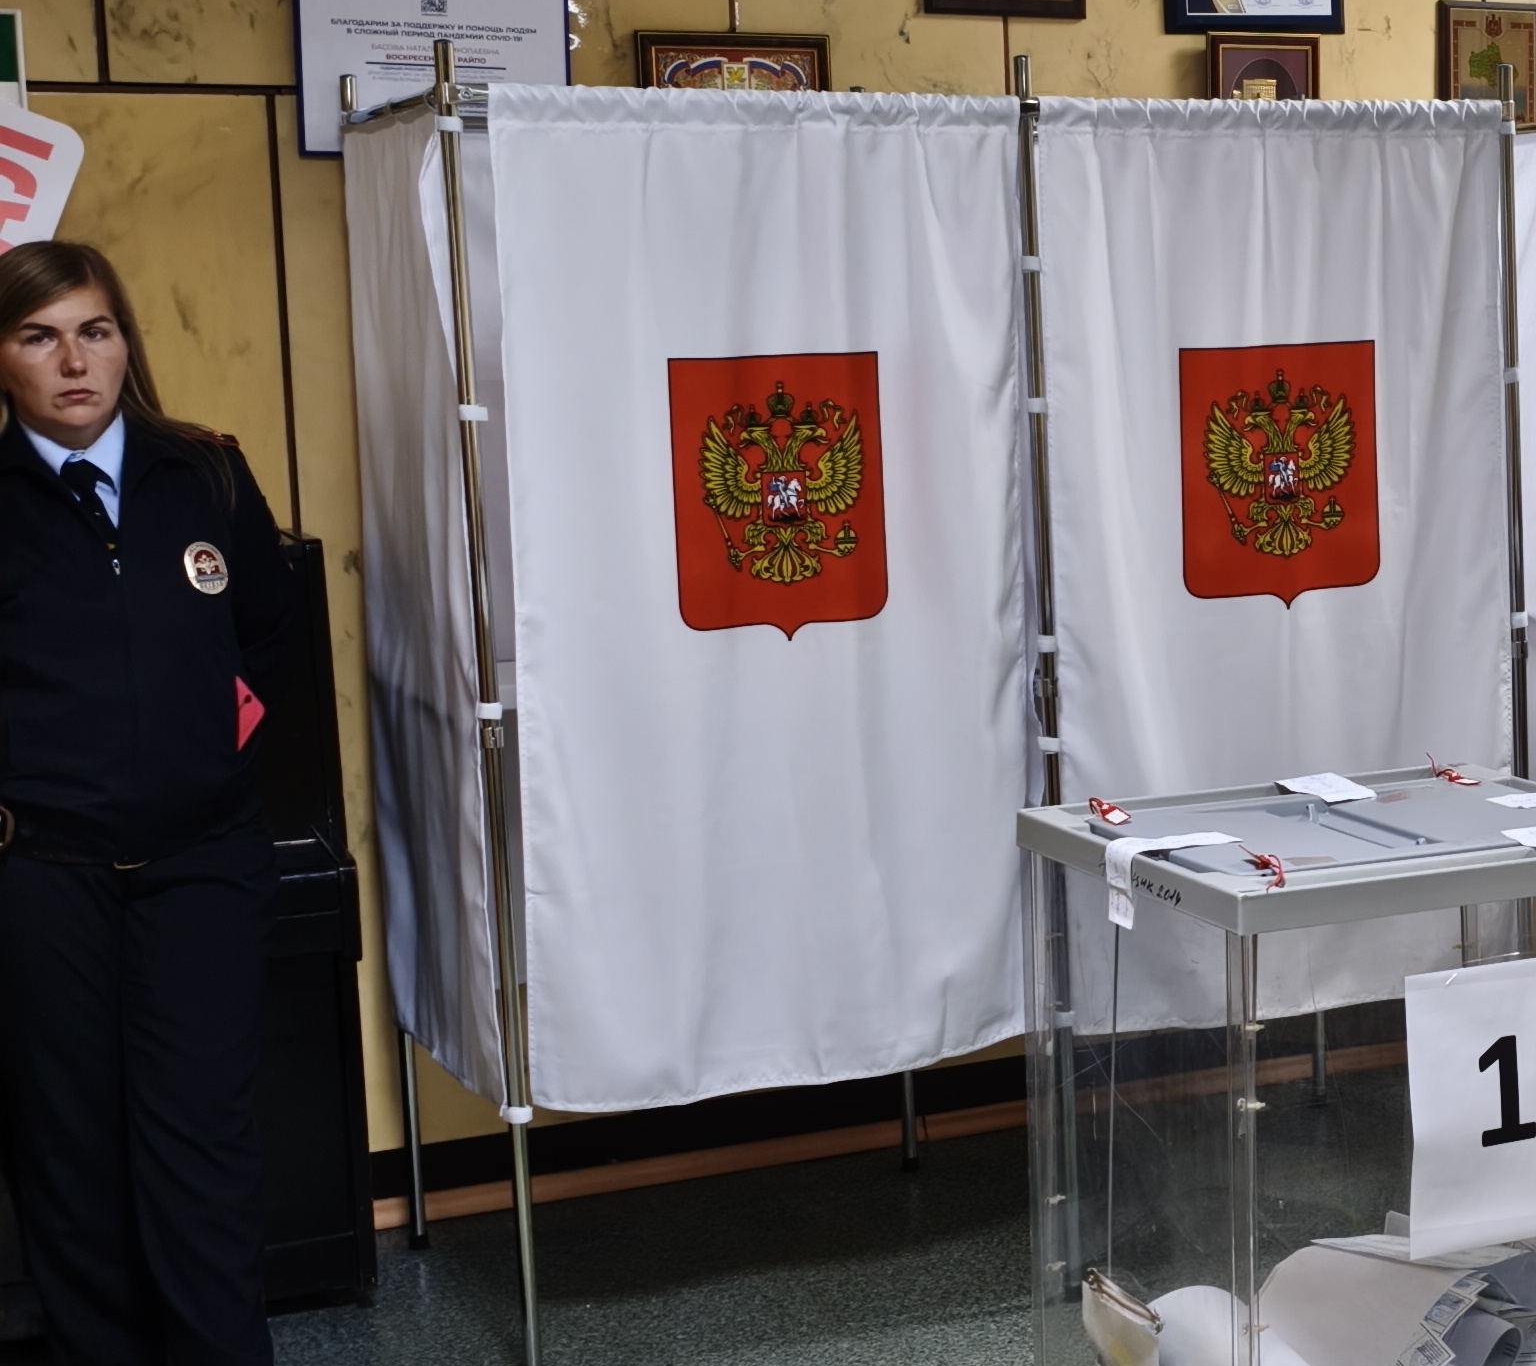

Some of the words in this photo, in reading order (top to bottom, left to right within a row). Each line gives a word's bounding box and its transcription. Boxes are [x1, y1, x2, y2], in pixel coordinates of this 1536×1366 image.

[331, 18, 389, 28] БЛАГОДАРИМ
[403, 21, 455, 31] ПОДДЕРЖКУ
[465, 24, 504, 34] ПОМОЩЬ
[505, 26, 537, 35] ЛЮДЯМ
[354, 27, 399, 36] СЛОЖНЫЙ
[401, 30, 435, 38] ПЕРИОД
[437, 31, 484, 40] ПАНДЕМИИ
[457, 56, 487, 65] РАЙПО
[1156, 884, 1182, 907] 2014
[1478, 1034, 1536, 1148] 1
